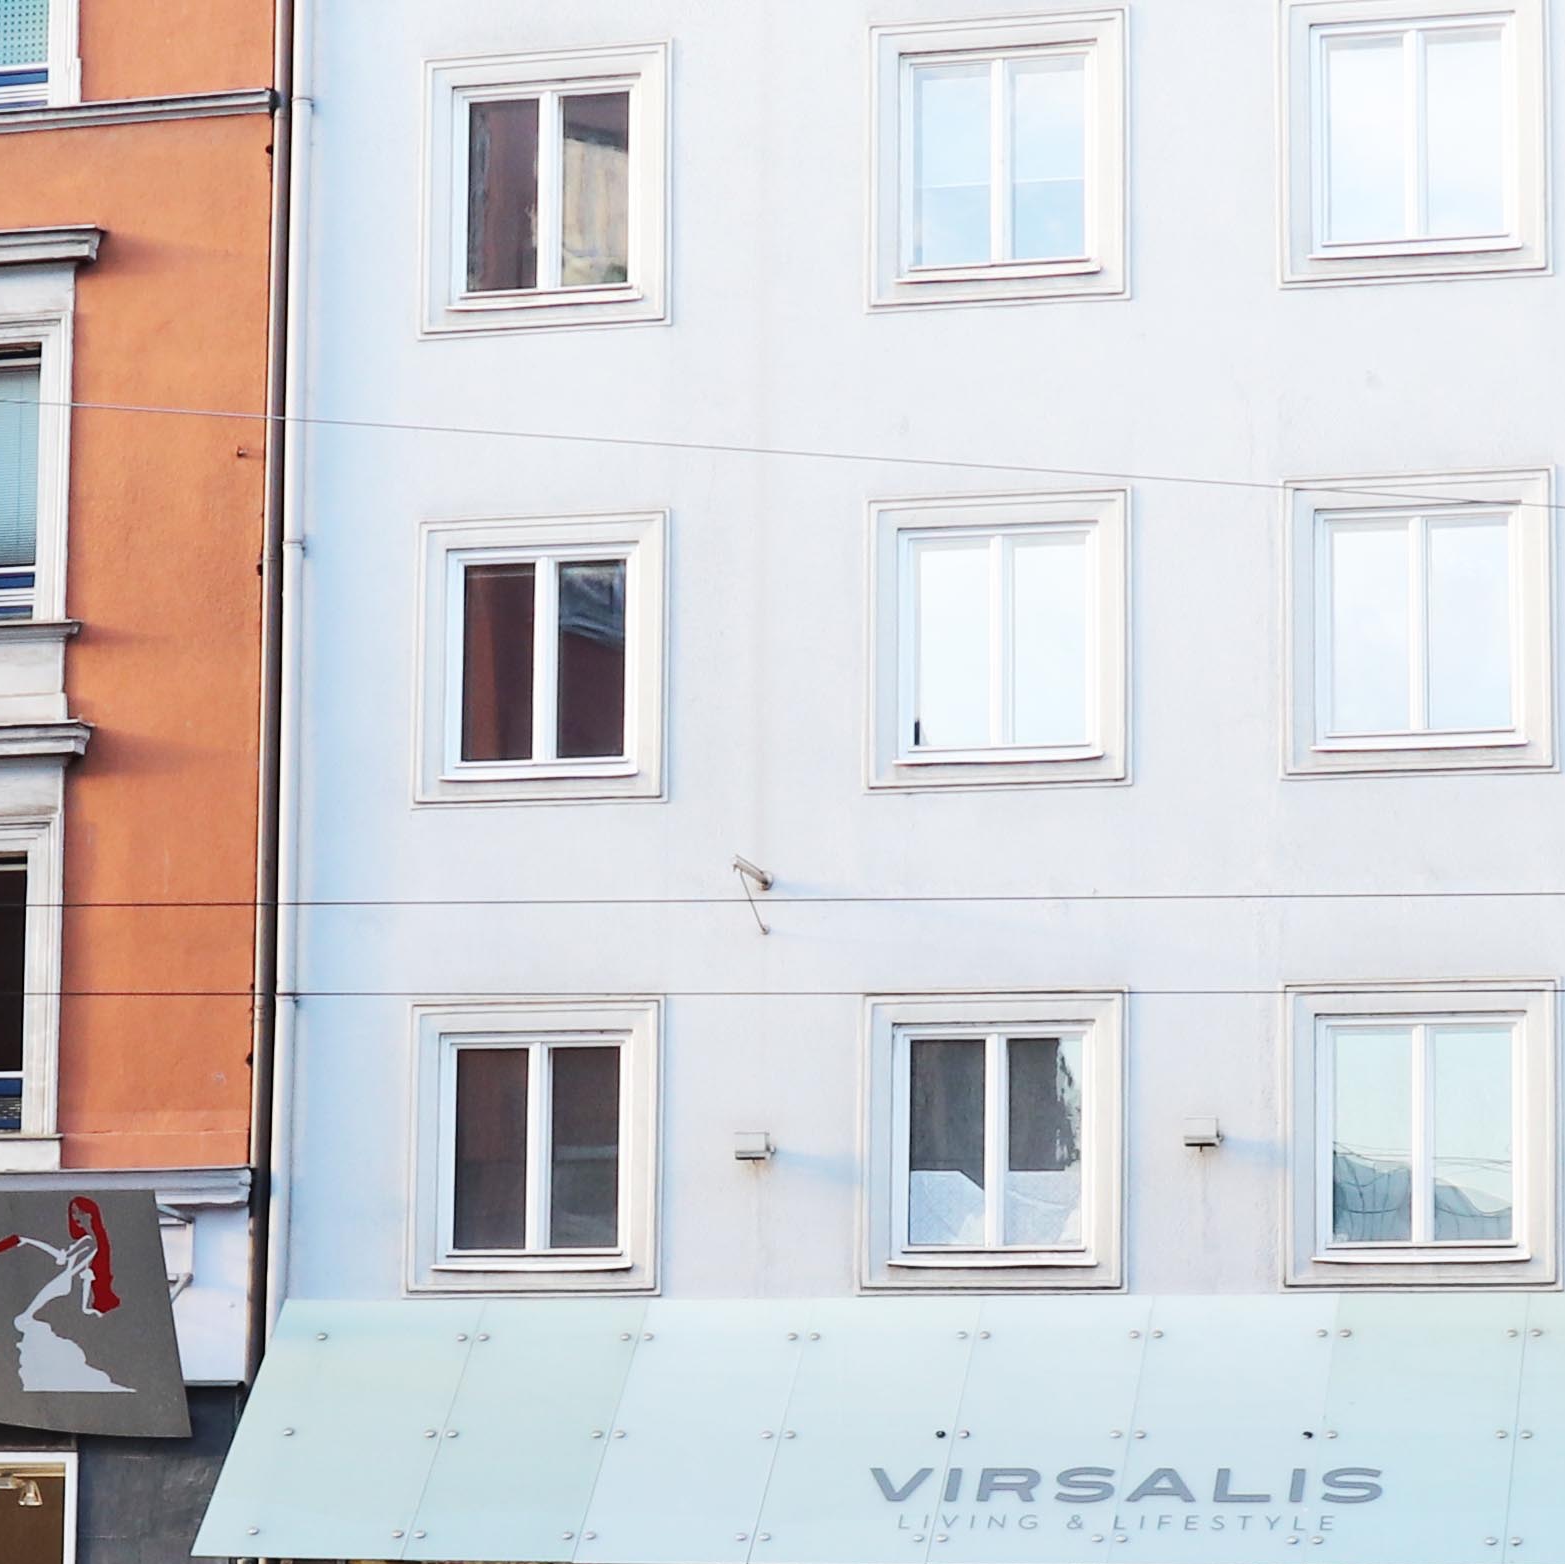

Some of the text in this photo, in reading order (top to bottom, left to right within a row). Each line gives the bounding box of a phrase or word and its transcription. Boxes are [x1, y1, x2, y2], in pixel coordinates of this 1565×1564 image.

[870, 1466, 1383, 1504] VIRSALIS
[898, 1514, 1335, 1531] LIVING & LIFESTYLE
